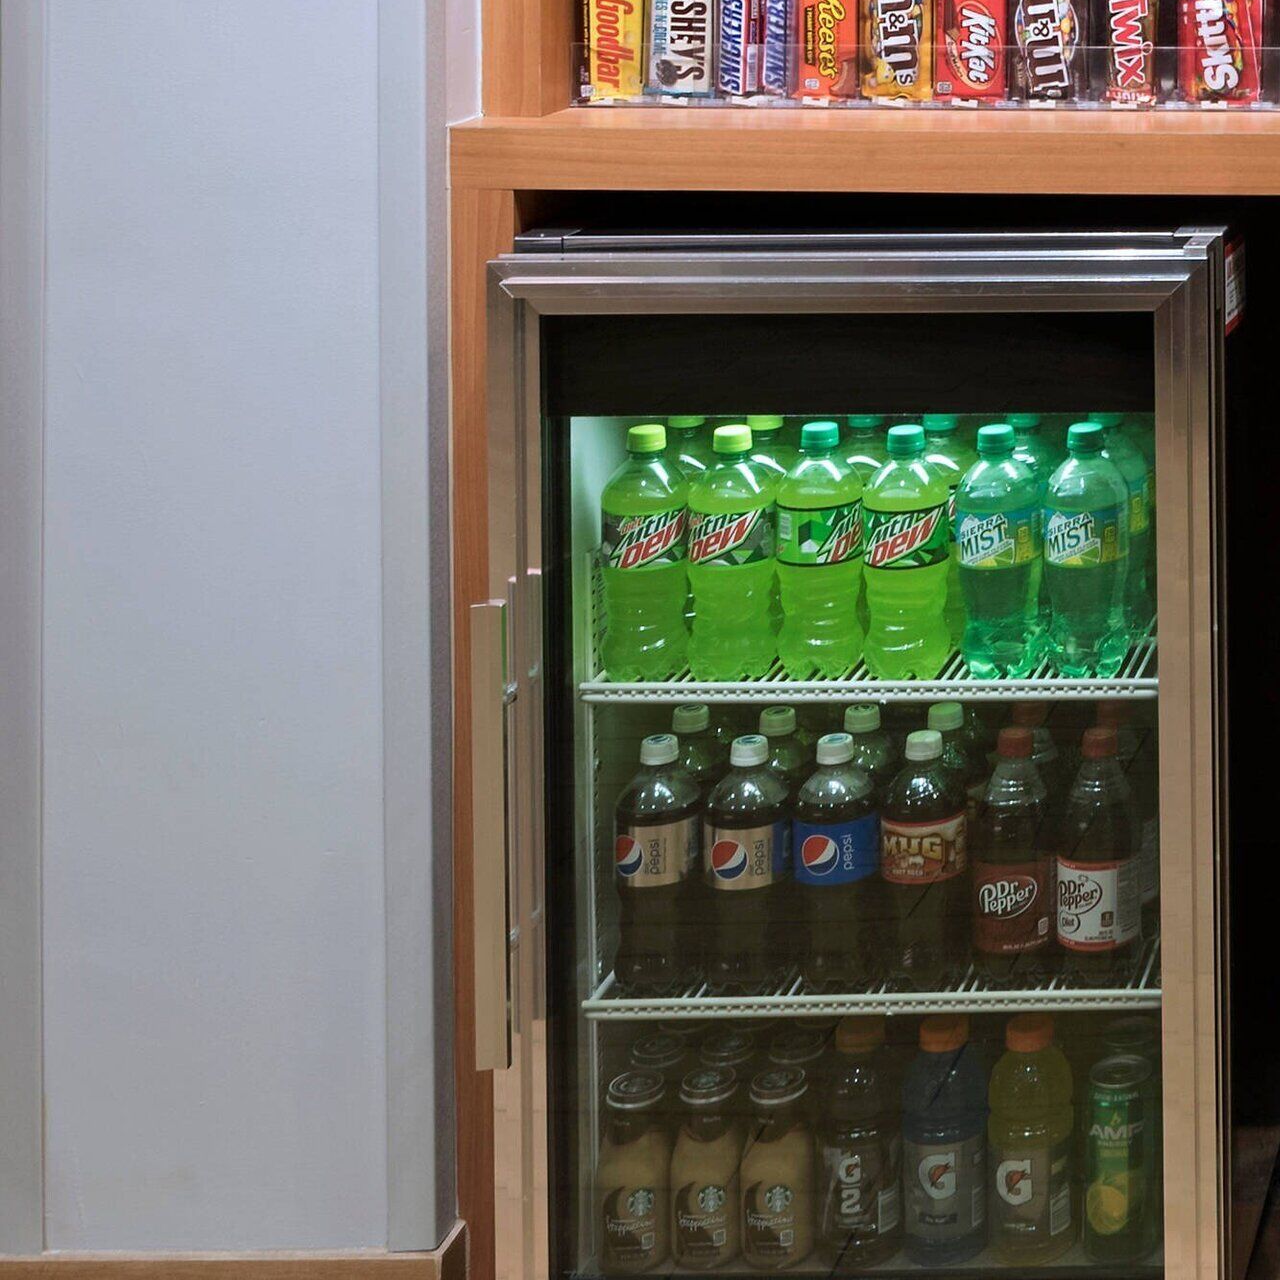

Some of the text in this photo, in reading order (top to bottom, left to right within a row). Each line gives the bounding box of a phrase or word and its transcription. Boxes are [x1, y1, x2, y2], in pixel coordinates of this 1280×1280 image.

[960, 512, 1005, 540] SIERRA
[960, 523, 1007, 559] MIST
[1047, 511, 1091, 539] SIERRA
[1048, 521, 1093, 556] MIST
[649, 837, 661, 876] pepsi
[755, 839, 767, 877] pepsi
[842, 834, 856, 871] pepsi
[882, 834, 943, 862] MUG
[983, 881, 1037, 916] Pepper
[1000, 880, 1020, 898] Dr
[1058, 880, 1099, 913] Pepper
[918, 1152, 957, 1200] G
[996, 1159, 1033, 1206] G
